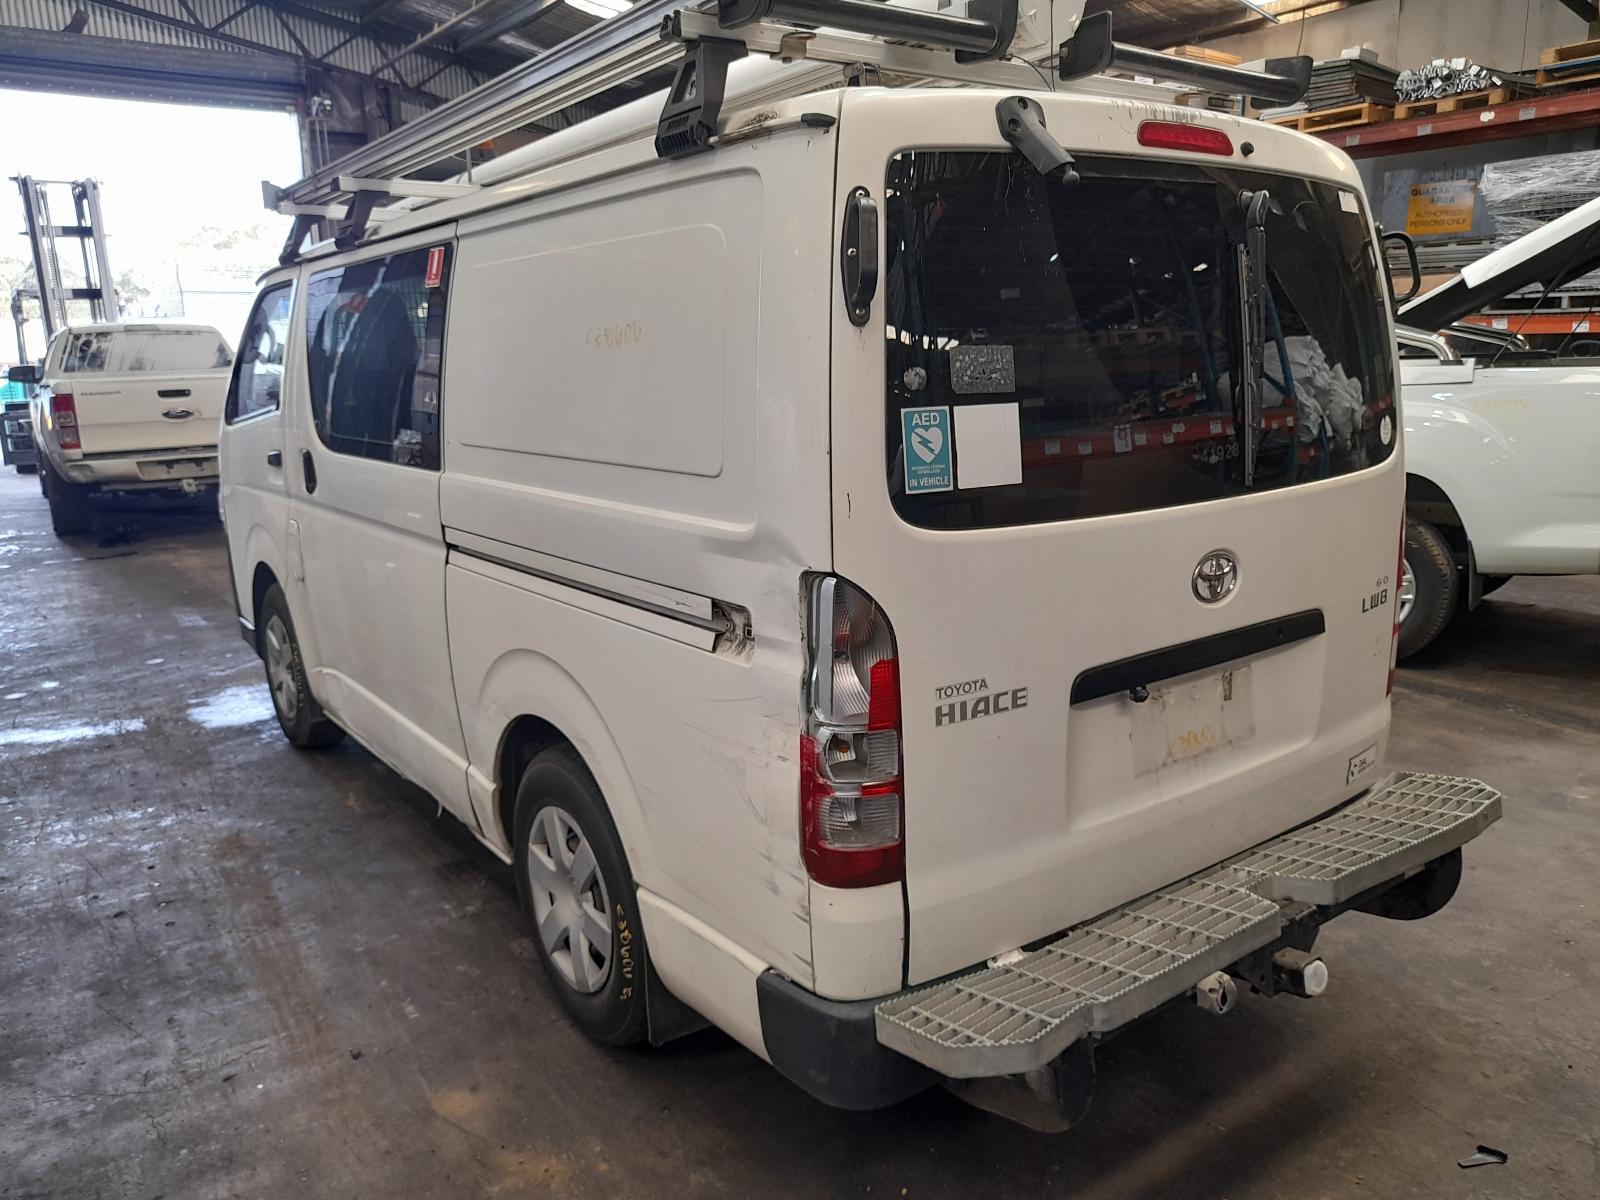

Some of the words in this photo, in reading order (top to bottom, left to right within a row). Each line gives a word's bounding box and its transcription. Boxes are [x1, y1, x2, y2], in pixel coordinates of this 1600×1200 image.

[1415, 209, 1464, 219] AUTHORISED
[1409, 219, 1446, 228] PERSONS
[1446, 217, 1466, 226] ONLY
[911, 412, 940, 427] AED
[909, 479, 918, 488] IN
[918, 475, 950, 488] VEHICLE
[1361, 588, 1388, 614] LWB
[935, 678, 988, 701] TOYOTA
[935, 686, 1029, 728] HIACE
